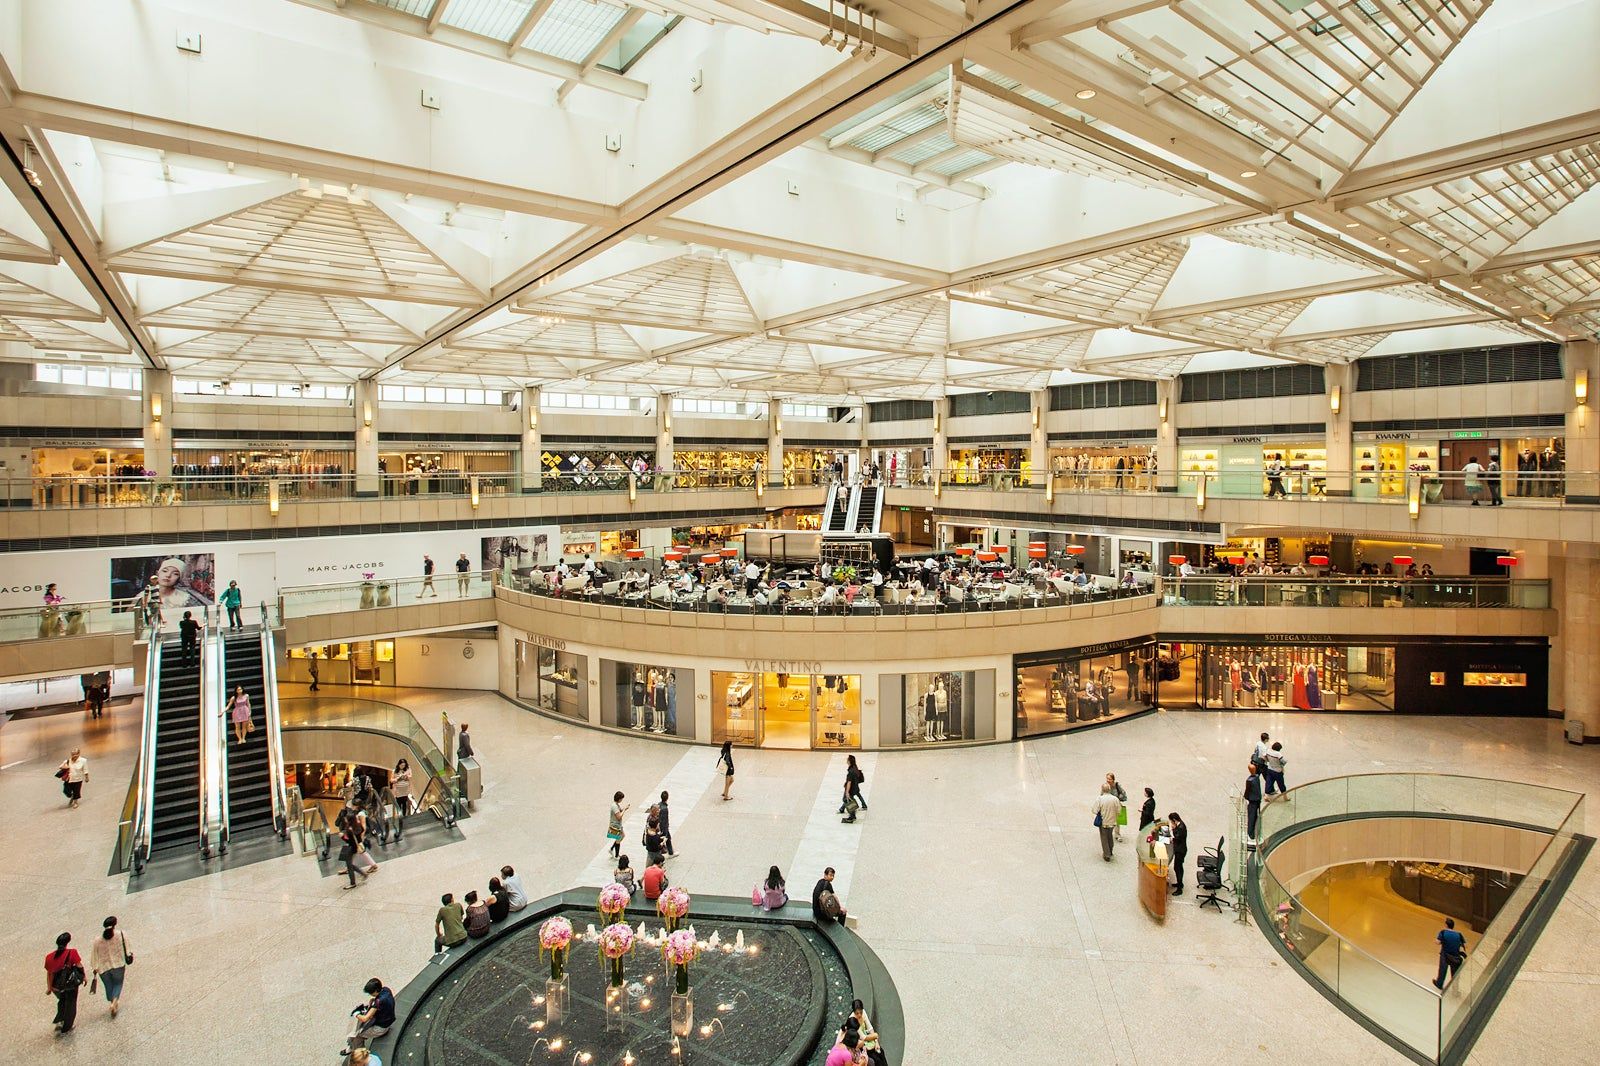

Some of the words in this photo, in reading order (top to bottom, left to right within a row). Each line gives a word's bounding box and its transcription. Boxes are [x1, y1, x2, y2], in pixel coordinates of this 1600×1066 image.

[1232, 436, 1261, 444] KWANPEN
[1375, 431, 1411, 440] KWANPEN
[342, 561, 385, 571] JACOBS
[526, 632, 567, 651] VALENTINO
[1264, 633, 1300, 642] BOTTEGA
[1080, 644, 1108, 654] BOTTEGA
[744, 659, 823, 674] VALENTINO
